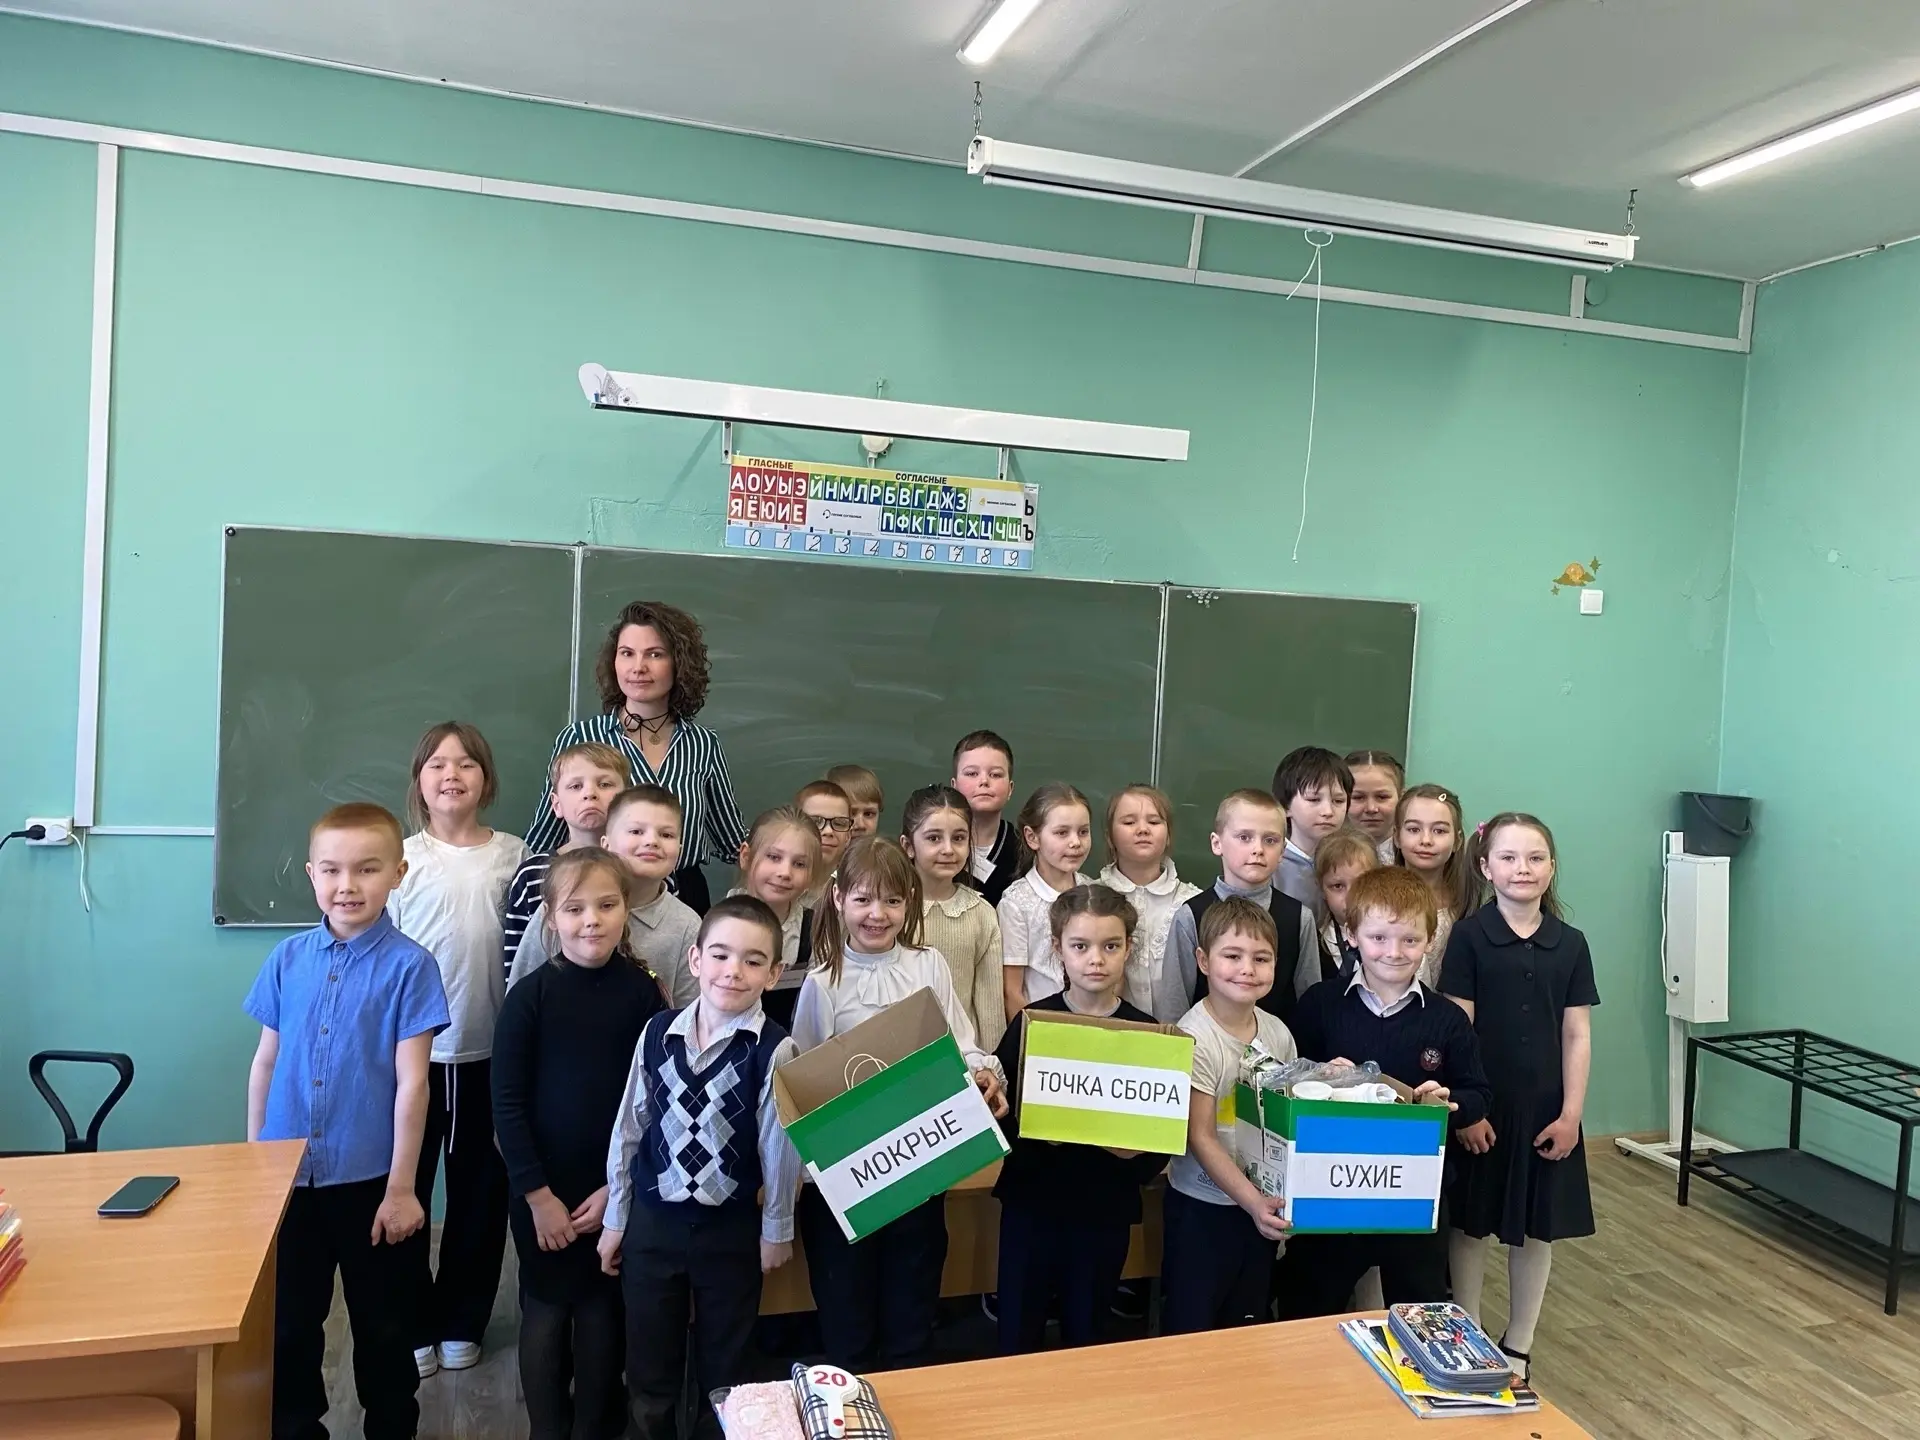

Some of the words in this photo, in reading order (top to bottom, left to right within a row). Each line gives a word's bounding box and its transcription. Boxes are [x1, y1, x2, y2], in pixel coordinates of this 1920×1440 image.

[748, 459, 793, 469] ГЛАСНЫЕ
[896, 473, 947, 484] СОГЛАСНЫЕ
[749, 530, 761, 546] 0
[783, 533, 792, 549] 1
[809, 535, 822, 551] 2
[838, 537, 851, 553] 3
[870, 540, 879, 556] 4
[896, 541, 908, 558] 5
[925, 545, 936, 560] 6
[954, 546, 964, 562] 7
[981, 549, 991, 564] 8
[1008, 551, 1018, 566] 9
[1037, 1070, 1103, 1097] ТОЧКА
[1111, 1078, 1180, 1105] СБОРА
[849, 1109, 963, 1188] МОКРЫЕ
[1329, 1165, 1403, 1188] СУХИЕ
[813, 1371, 847, 1387] 20
